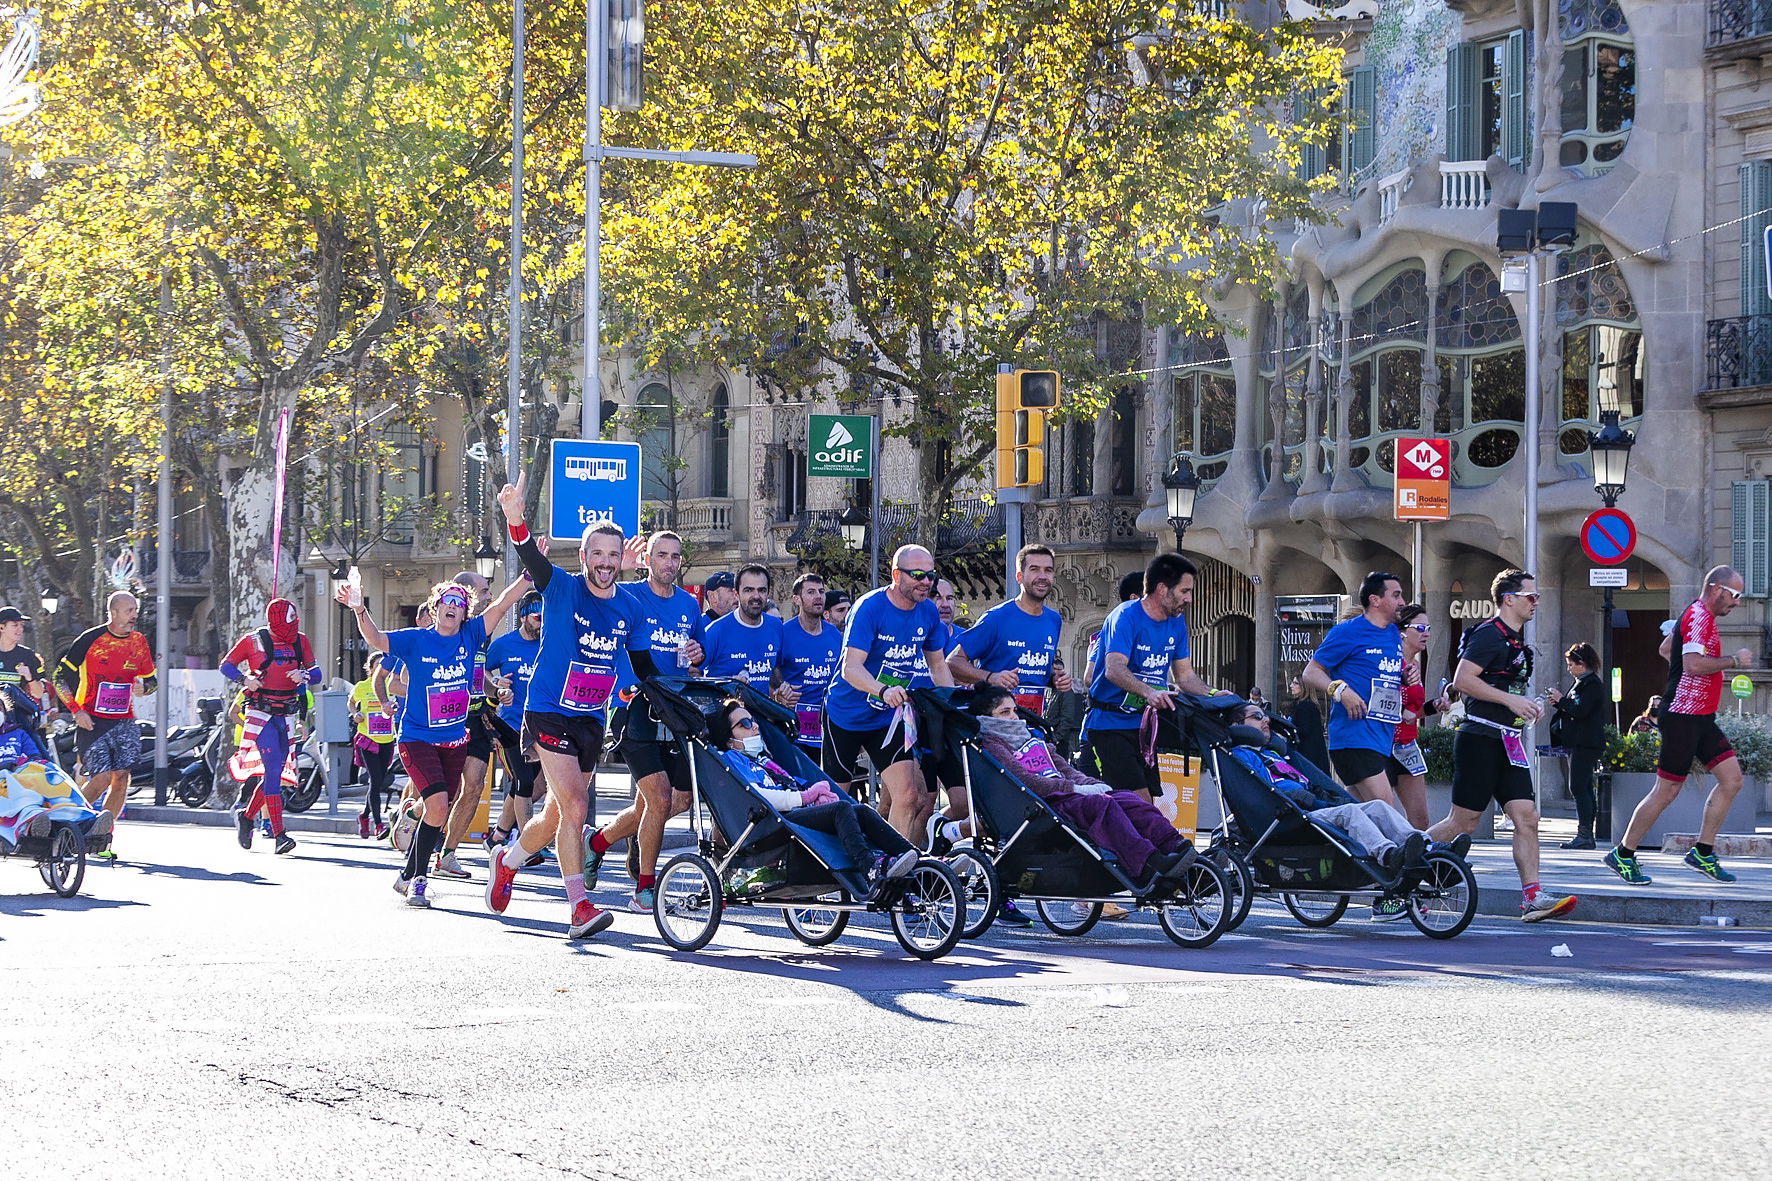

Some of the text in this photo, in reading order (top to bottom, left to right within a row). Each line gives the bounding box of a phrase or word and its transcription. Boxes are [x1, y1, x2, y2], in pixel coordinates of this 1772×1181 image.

[815, 448, 863, 463] adif
[1416, 450, 1431, 463] M
[1406, 491, 1416, 502] R
[1418, 495, 1448, 503] Rodalies
[577, 505, 613, 523] taxi
[1281, 628, 1311, 645] Shiva
[1280, 645, 1314, 662] Massa
[572, 685, 605, 699] 15173
[440, 702, 461, 714] 882
[1380, 699, 1397, 711] 1157
[1025, 756, 1048, 769] 152
